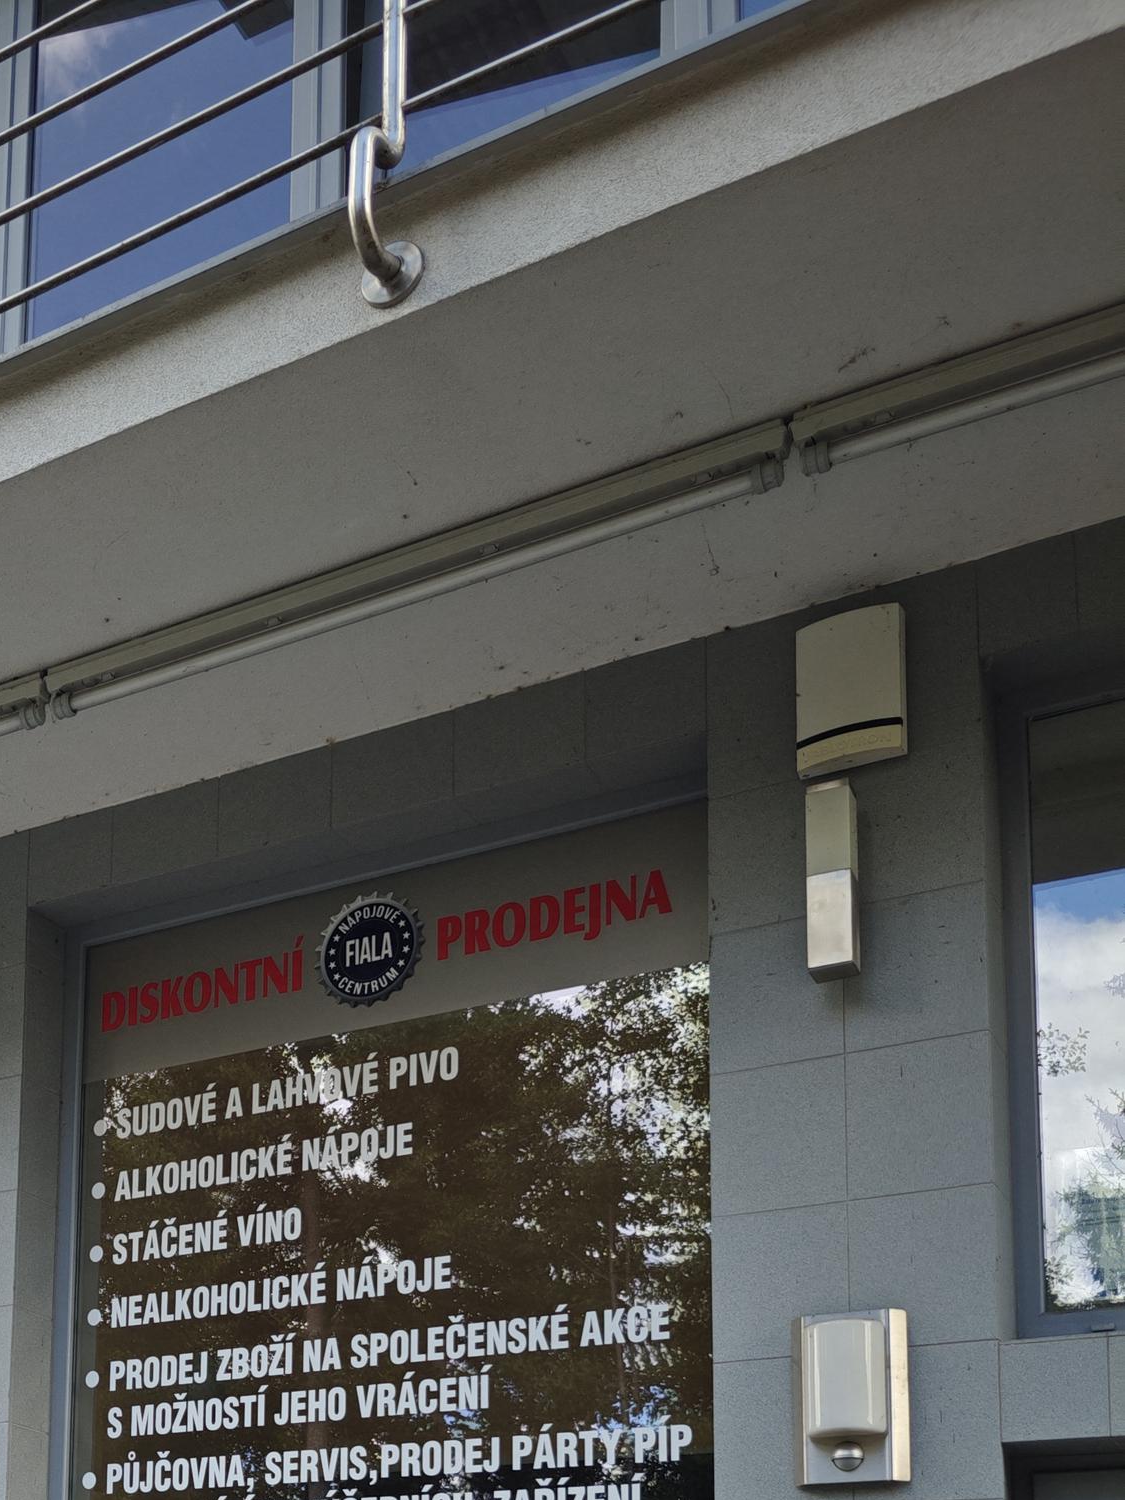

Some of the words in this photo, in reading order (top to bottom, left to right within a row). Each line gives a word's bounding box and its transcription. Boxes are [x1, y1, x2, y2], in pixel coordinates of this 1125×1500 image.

[338, 905, 401, 934] NÁPOJOVÉ
[345, 931, 393, 967] FIALA
[436, 869, 673, 960] PRODEJNA
[100, 935, 305, 1033] DISKONTNÍ
[338, 966, 400, 995] CENTRUM
[116, 1082, 216, 1139] SUDOVÉ
[225, 1087, 243, 1120] A
[252, 1052, 379, 1115] LAHVOVÉ
[389, 1046, 459, 1089] PIVO
[114, 1134, 293, 1202] ALKOHOLICKÉ
[301, 1122, 413, 1172] NÁPOJE
[112, 1210, 227, 1265] STÁČENÉ
[237, 1203, 302, 1247] VÍNO
[111, 1262, 326, 1328] NEALKOHOLICKÉ
[336, 1255, 451, 1302] NÁPOJE
[109, 1351, 208, 1392] PRODEJ
[216, 1332, 297, 1382] ZBOŽÍ
[303, 1337, 341, 1373] NA
[350, 1303, 569, 1368] SPOLEČENSKÉ
[580, 1304, 670, 1347] AKCE
[107, 1406, 123, 1439] S
[131, 1384, 269, 1437] MOŽNOSTÍ
[274, 1387, 346, 1426] JEHO
[356, 1364, 493, 1418] VRÁCENÍ
[106, 1451, 255, 1495] PŮJČOVNA,
[511, 1423, 624, 1472] PÁRTY
[633, 1414, 692, 1464] PÍP
